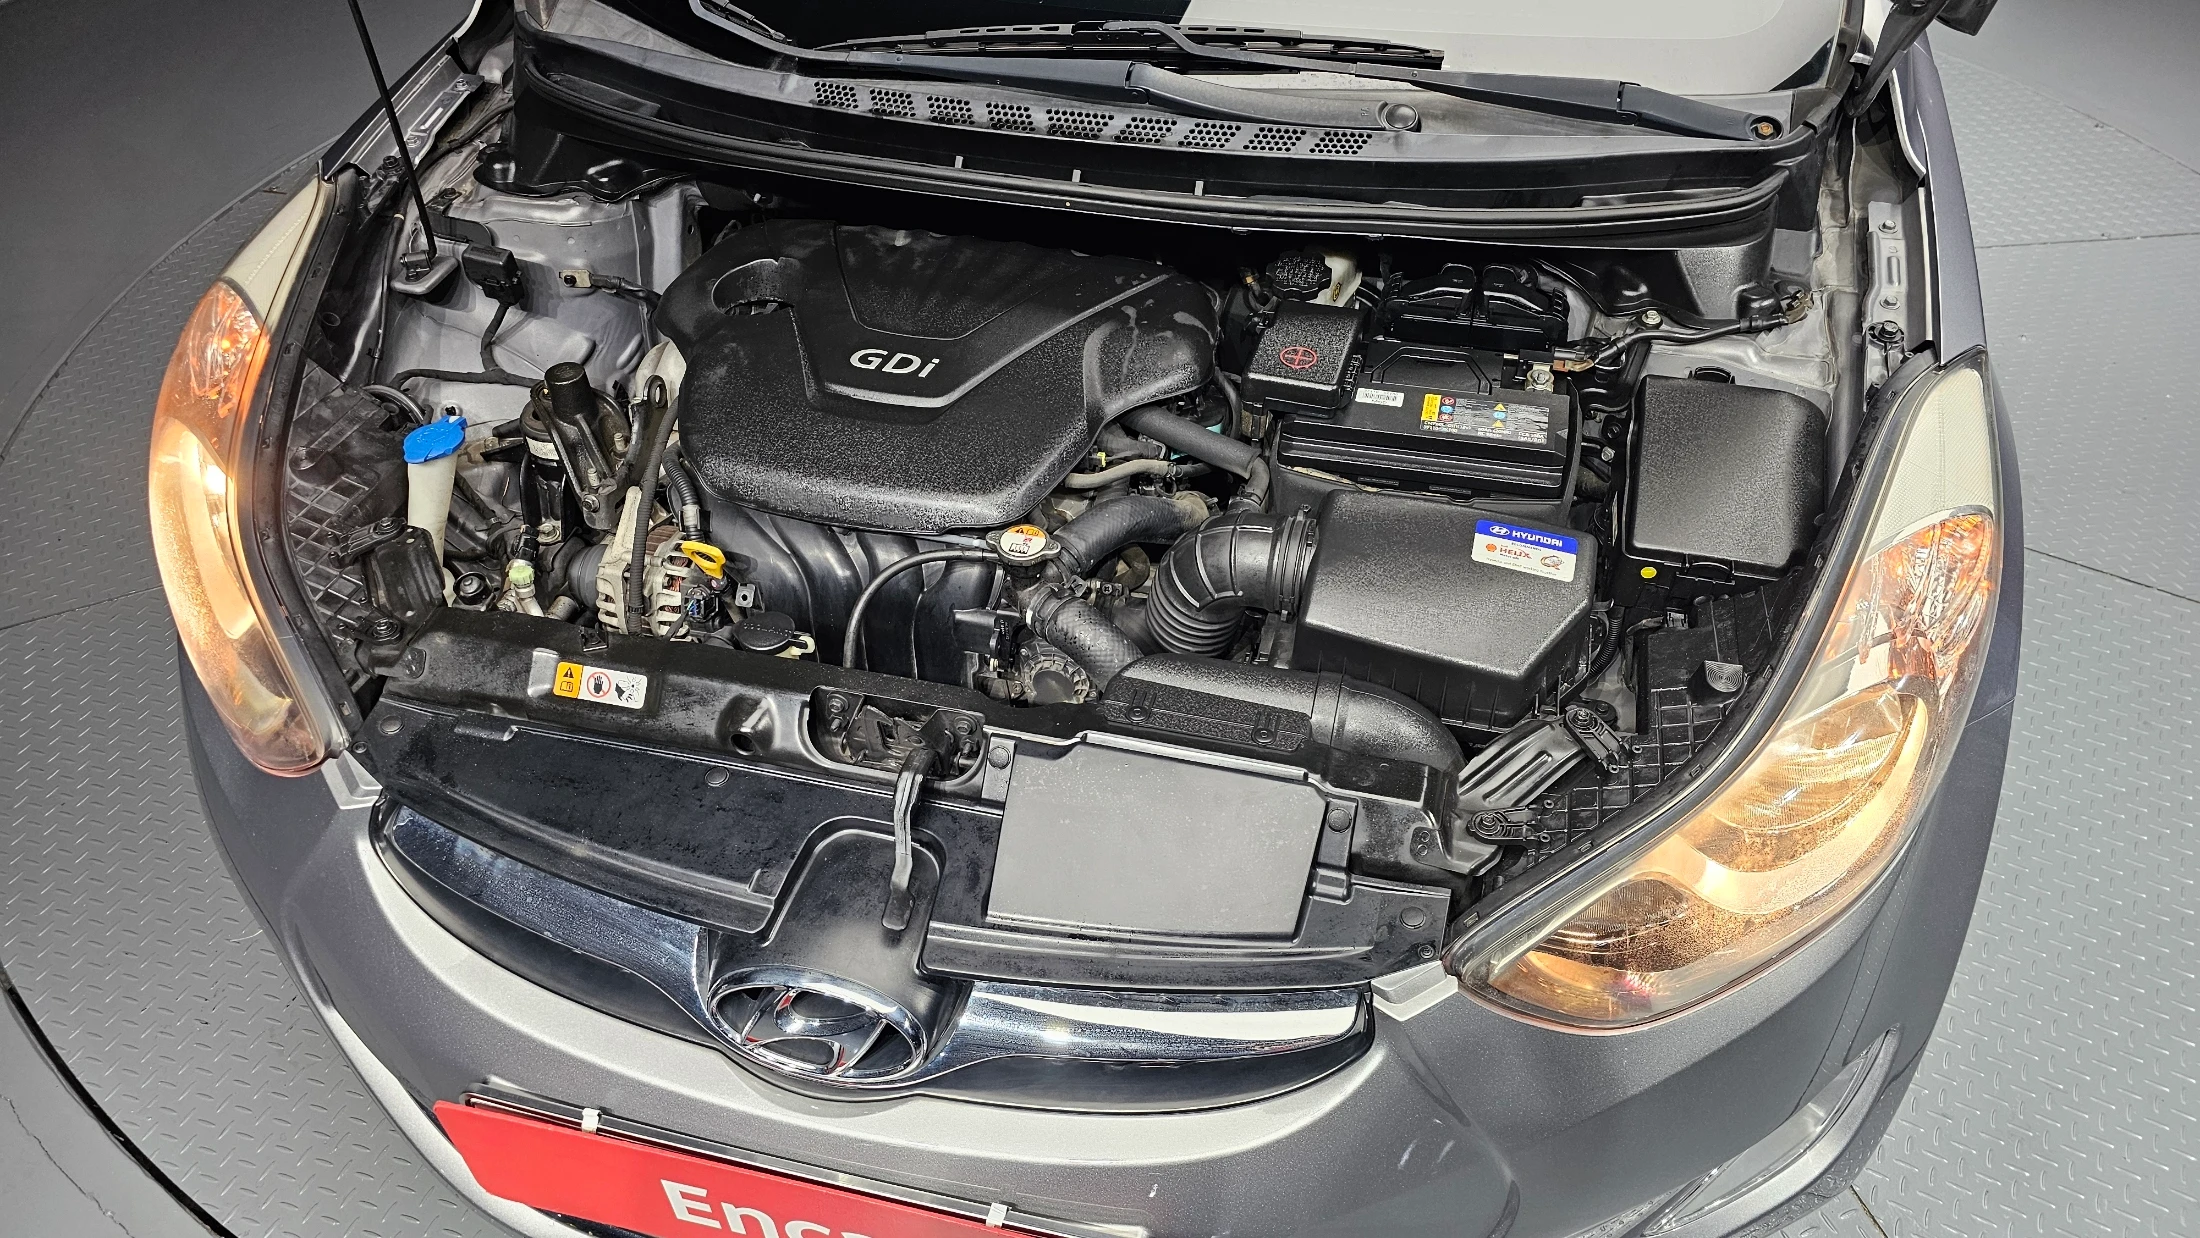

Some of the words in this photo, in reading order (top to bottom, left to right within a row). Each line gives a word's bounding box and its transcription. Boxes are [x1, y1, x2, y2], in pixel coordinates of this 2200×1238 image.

[849, 349, 940, 378] GDi
[1512, 530, 1563, 547] HYUNDAI
[1500, 547, 1532, 559] HELIX
[660, 1178, 872, 1238] Enc
